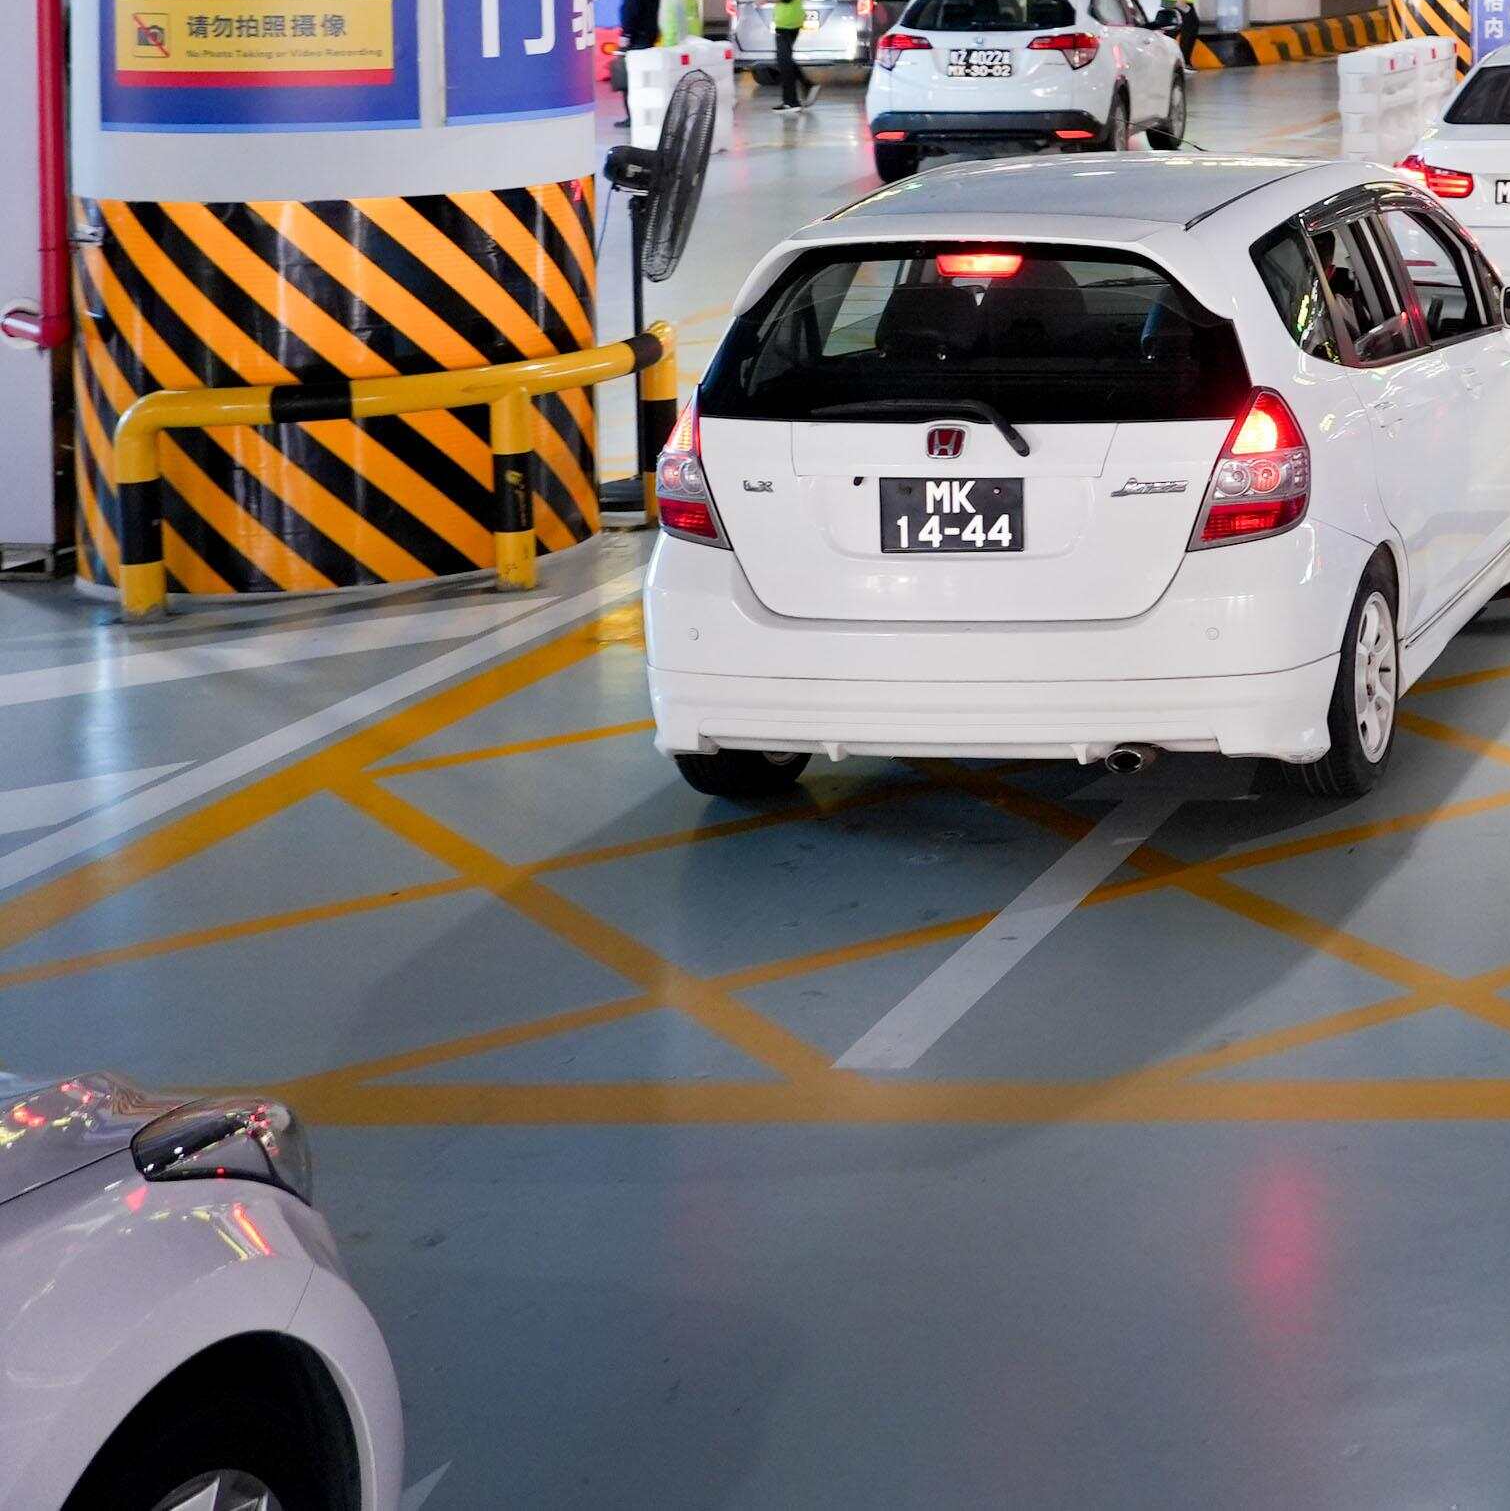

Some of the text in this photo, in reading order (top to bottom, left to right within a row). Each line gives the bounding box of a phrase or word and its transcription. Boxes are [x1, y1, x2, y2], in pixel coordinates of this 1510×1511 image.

[187, 14, 347, 38] 请勿拍照摄像
[925, 480, 976, 515] MK
[896, 514, 1013, 548] 14-44
